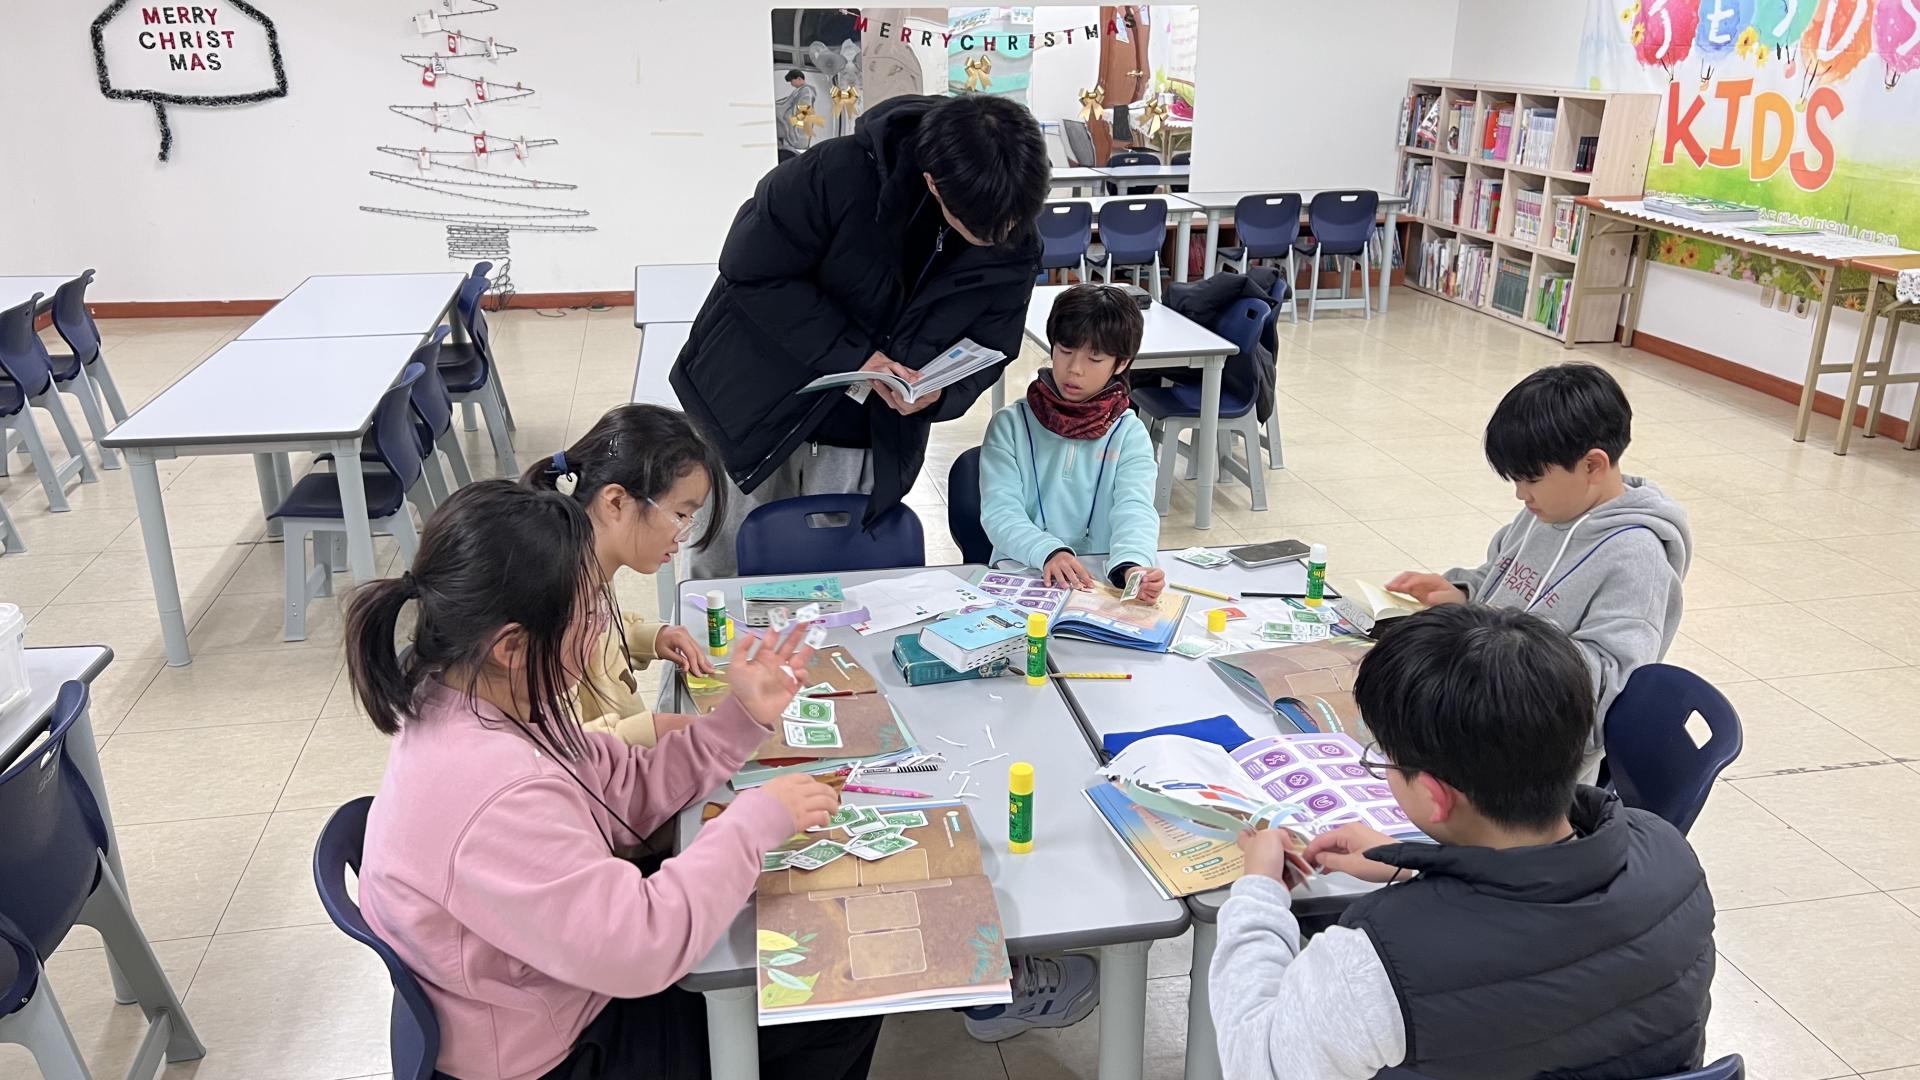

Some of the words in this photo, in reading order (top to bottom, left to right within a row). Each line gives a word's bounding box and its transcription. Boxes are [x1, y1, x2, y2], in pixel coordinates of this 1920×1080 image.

[142, 7, 218, 25] MERRY
[139, 30, 235, 50] CHRIST
[853, 15, 952, 49] MERRY
[169, 53, 222, 71] MAS
[1662, 78, 1845, 192] KIDS
